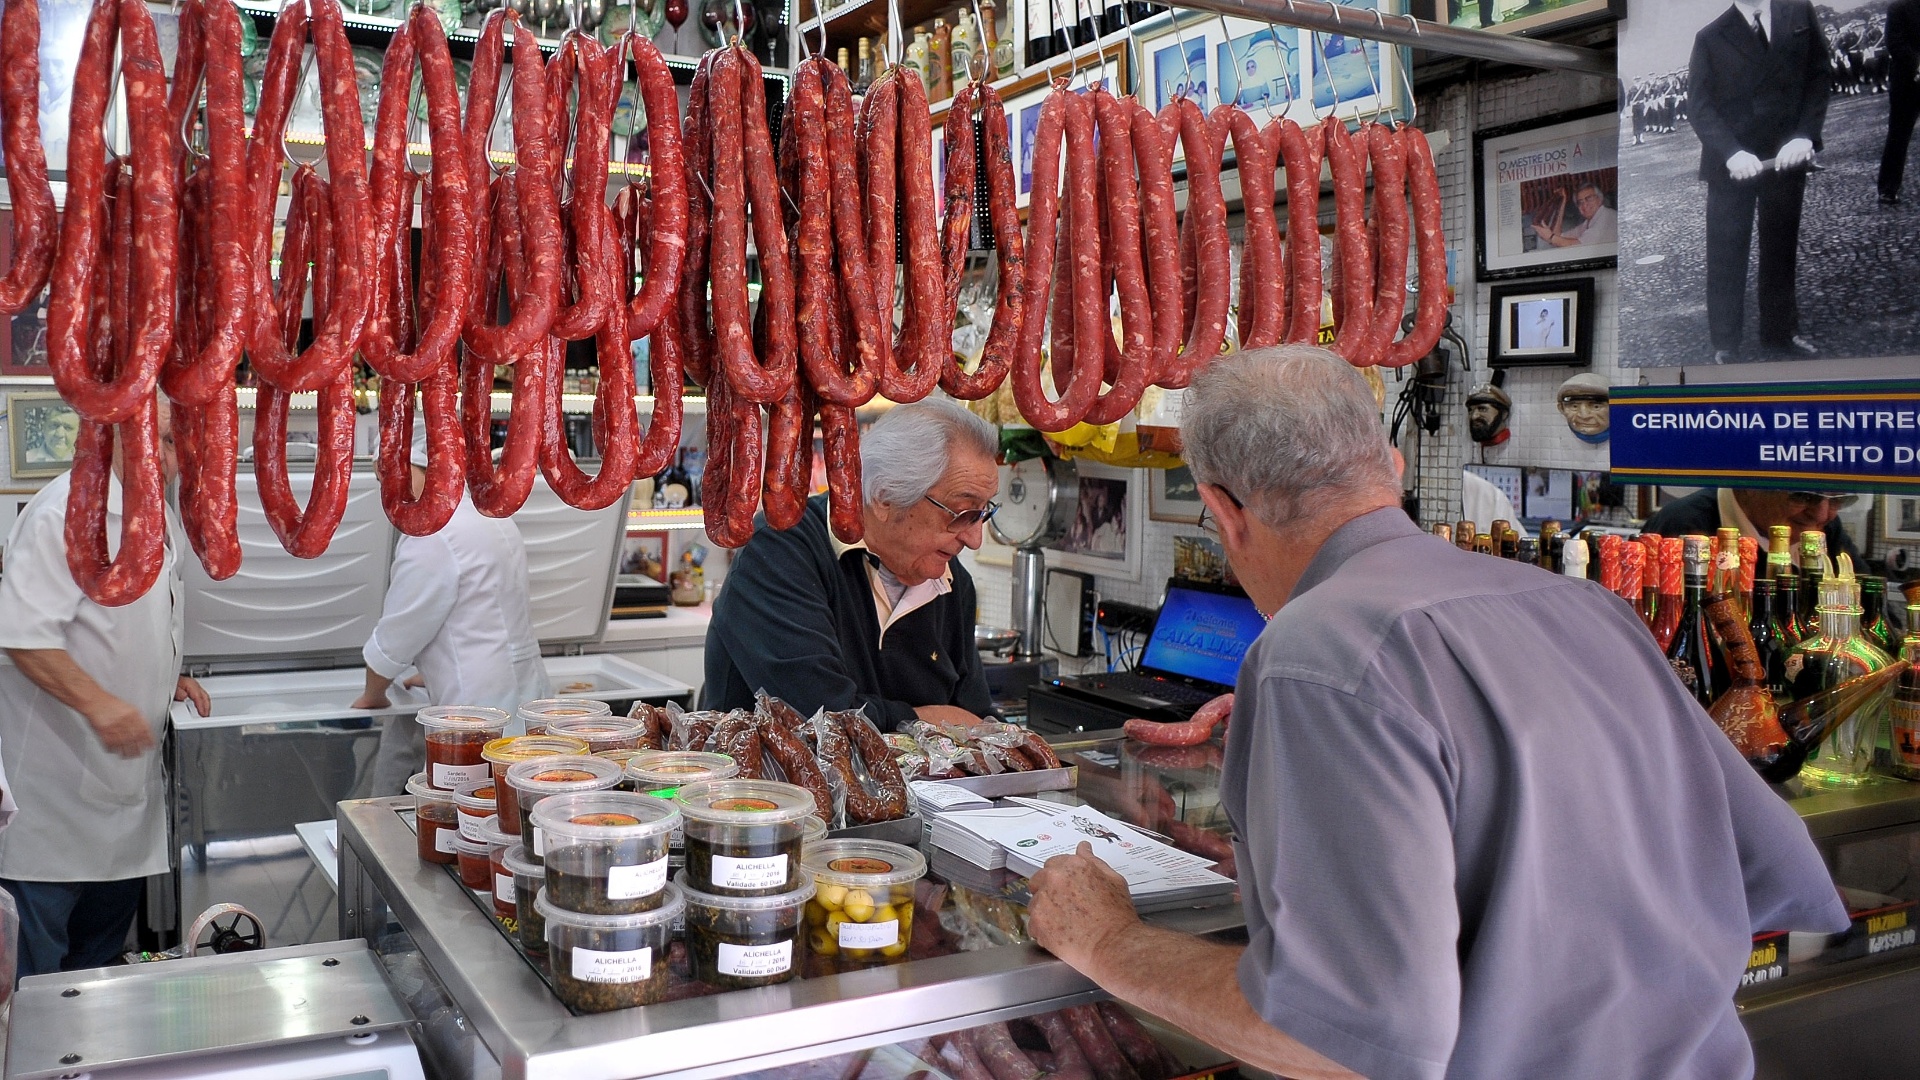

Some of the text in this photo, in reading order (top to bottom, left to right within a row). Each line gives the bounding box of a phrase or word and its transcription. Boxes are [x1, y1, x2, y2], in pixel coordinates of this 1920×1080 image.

[1498, 149, 1567, 171] O MESTRE DOS
[1499, 161, 1568, 184] EMBUTIDOS
[1631, 409, 1920, 429] CERIMÔNIA DE ENTRE
[1760, 441, 1920, 464] EMÉRITO D
[1155, 626, 1204, 648] CAIXA
[736, 862, 776, 870] ALICHELLA
[594, 957, 637, 965] ALICHELLA
[743, 949, 782, 958] ALICHELLA
